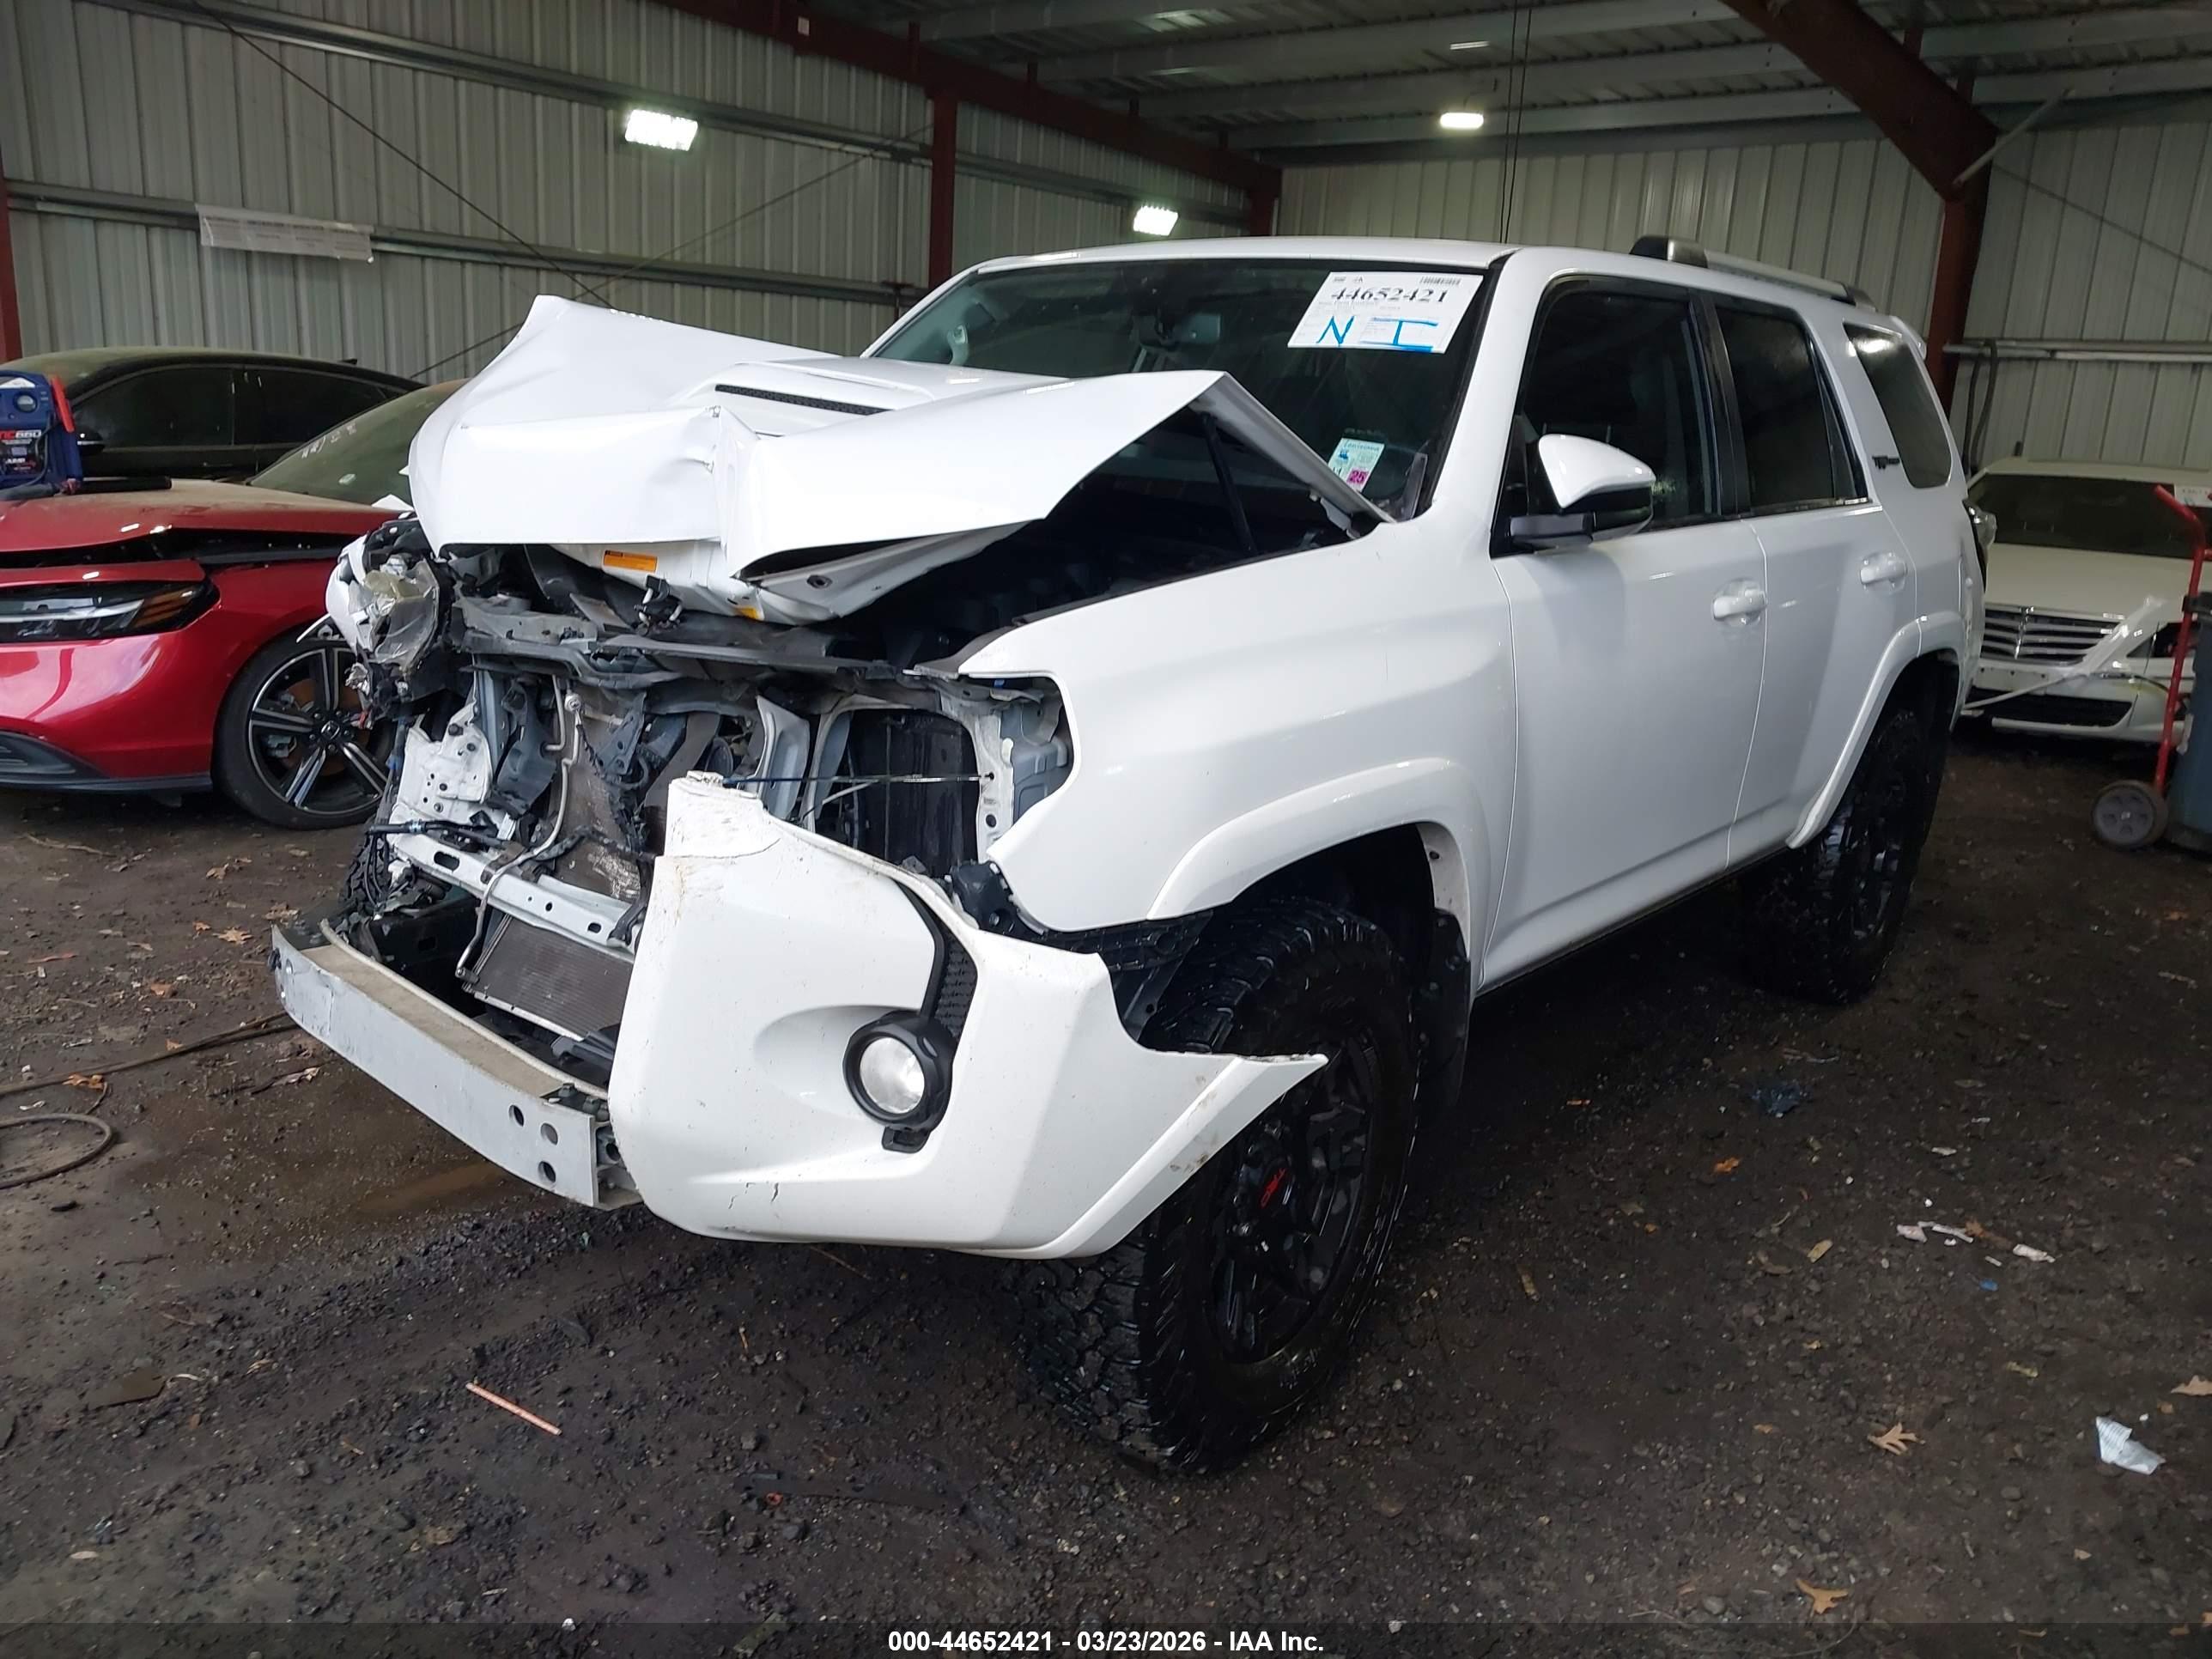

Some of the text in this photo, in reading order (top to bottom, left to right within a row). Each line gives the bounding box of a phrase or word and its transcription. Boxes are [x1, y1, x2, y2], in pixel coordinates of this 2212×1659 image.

[1331, 287, 1449, 303] 44652421
[1316, 315, 1355, 347] N
[1349, 469, 1368, 484] 25
